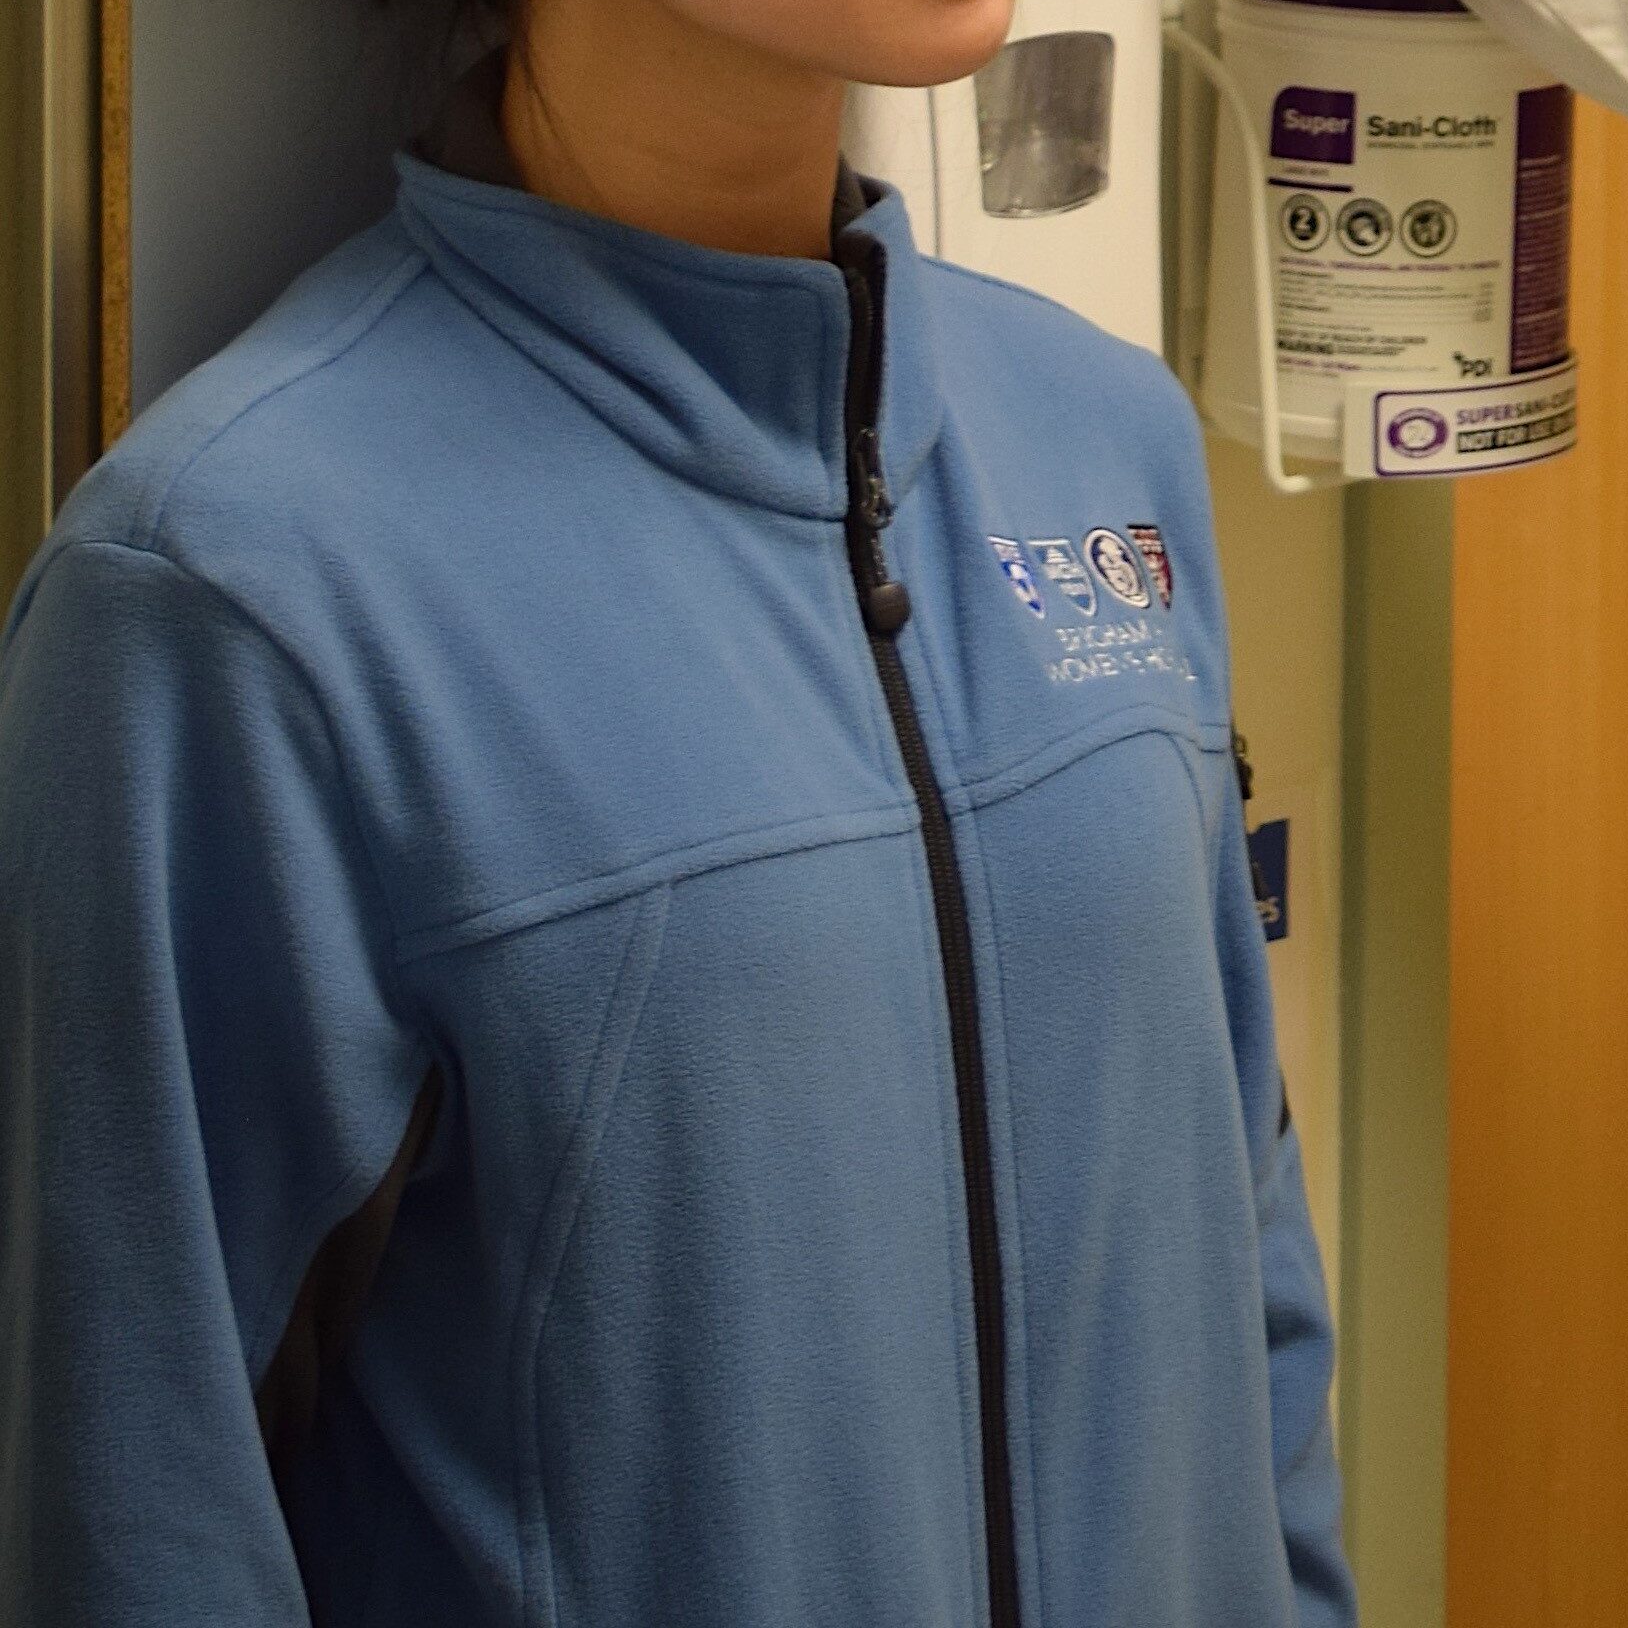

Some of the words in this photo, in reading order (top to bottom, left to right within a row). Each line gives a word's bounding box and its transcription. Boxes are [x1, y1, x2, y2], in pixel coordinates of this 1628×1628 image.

[1283, 107, 1349, 135] Super
[1366, 114, 1498, 138] Sani-Cloth
[1461, 358, 1493, 378] PDI
[1459, 430, 1493, 453] NOT
